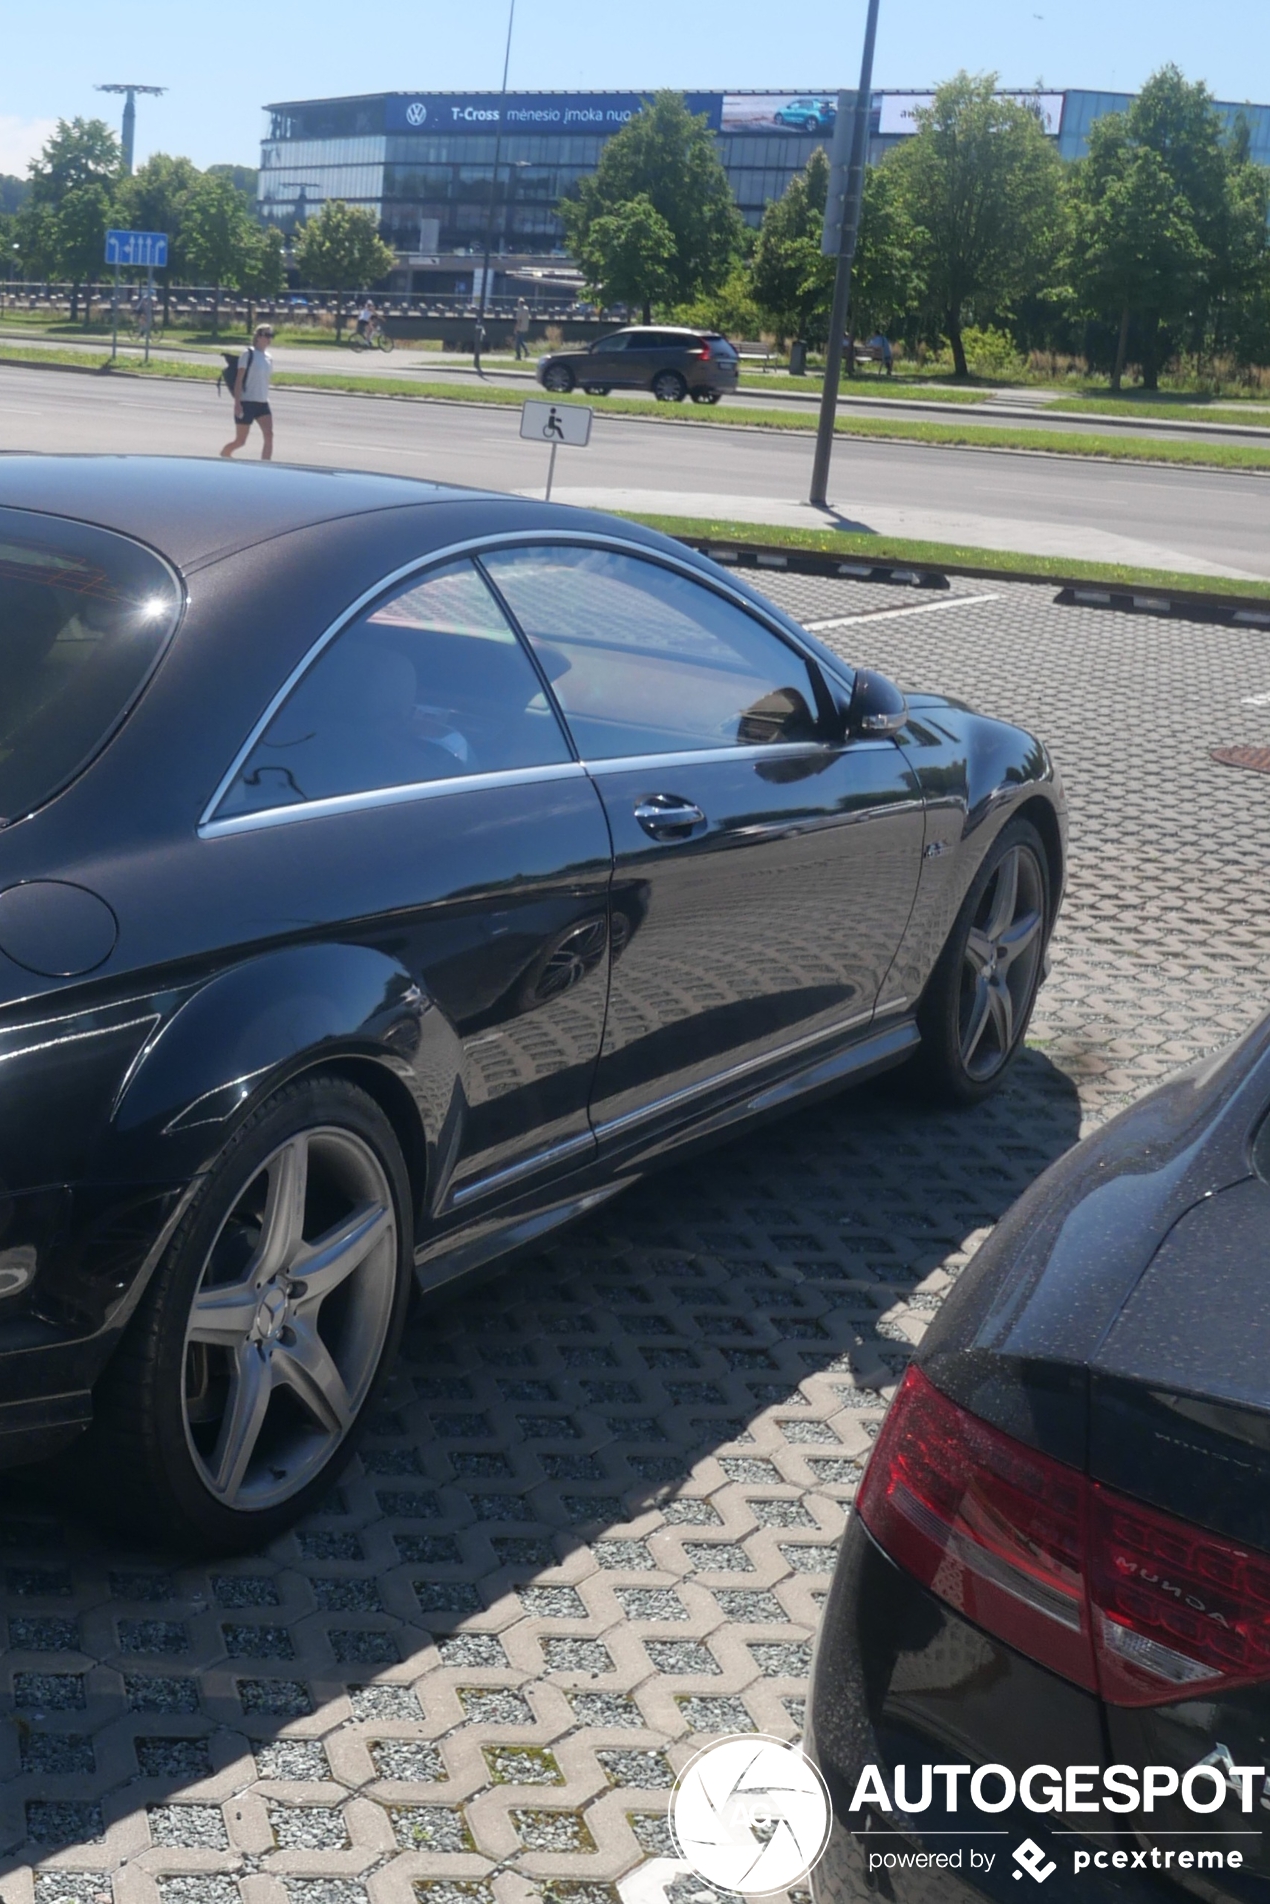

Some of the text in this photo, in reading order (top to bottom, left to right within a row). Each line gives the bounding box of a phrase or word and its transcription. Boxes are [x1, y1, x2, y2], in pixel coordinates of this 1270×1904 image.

[451, 107, 500, 121] T-Cross
[507, 108, 560, 121] mėnesio
[563, 108, 603, 125] įmoka
